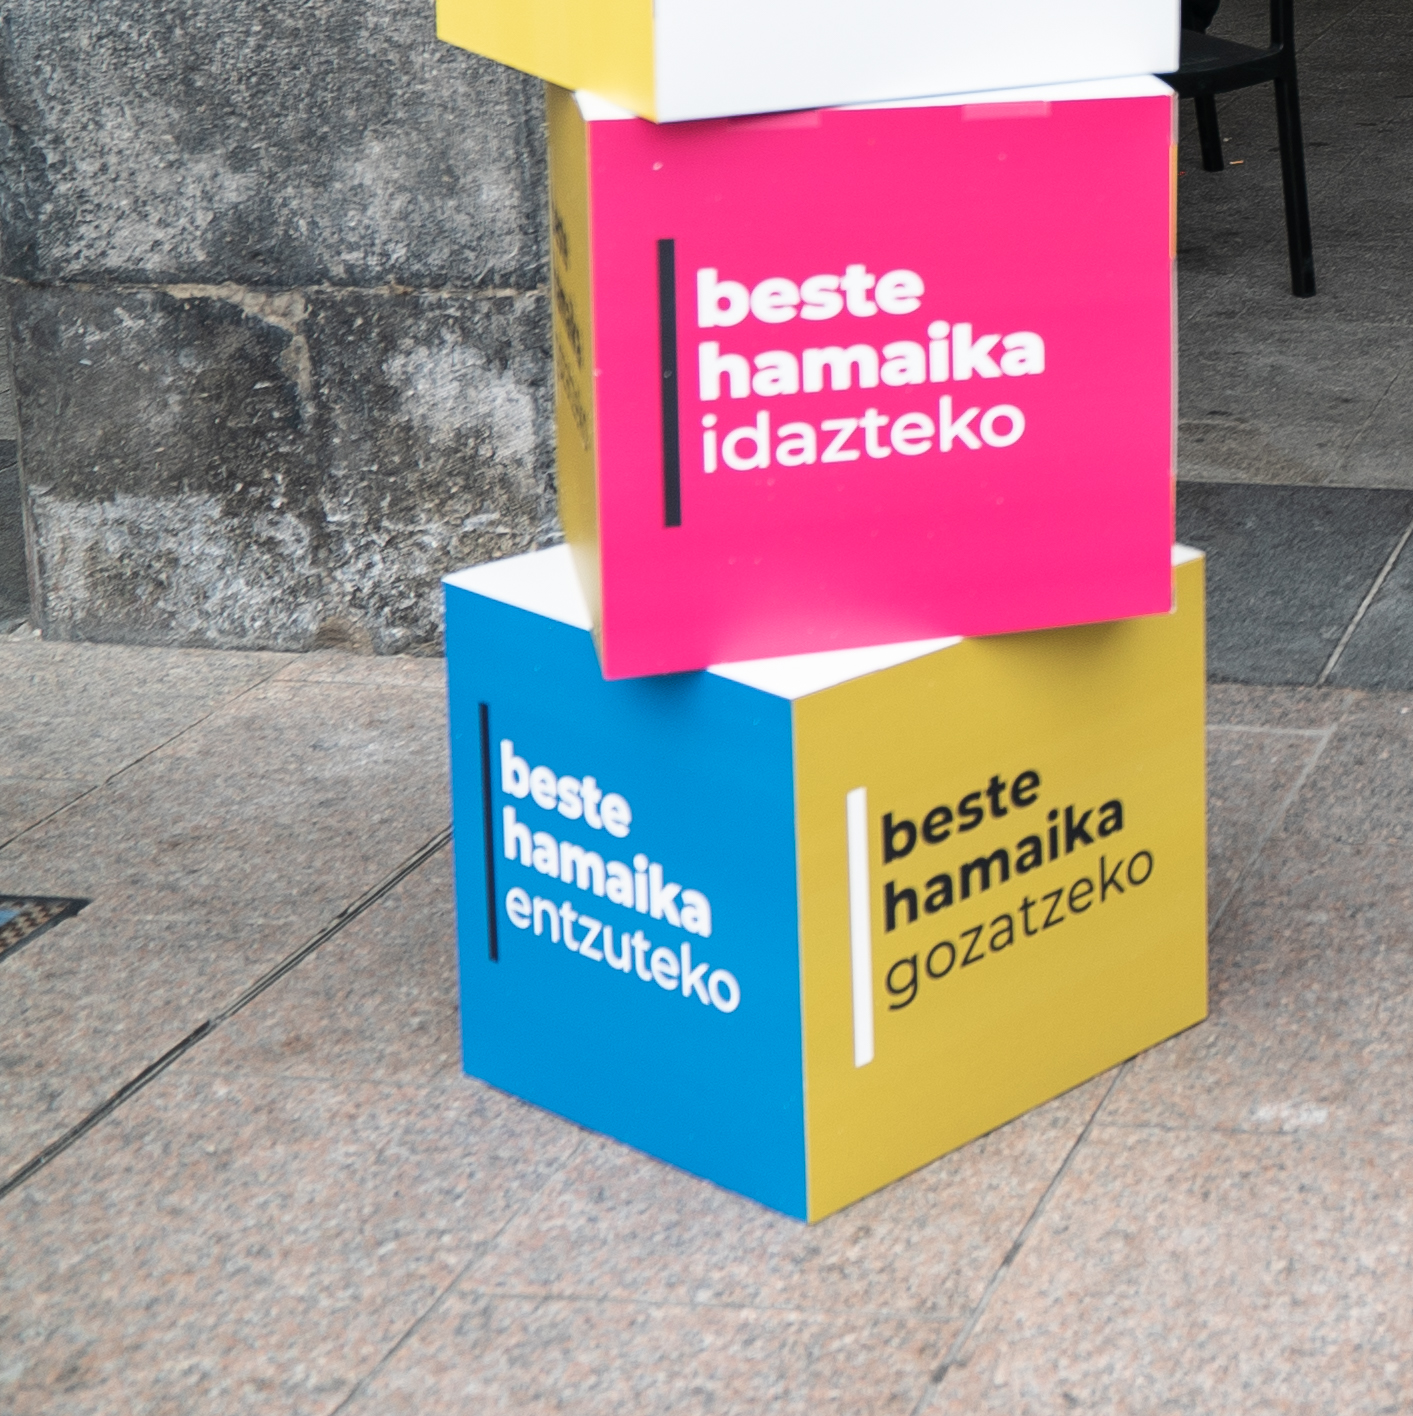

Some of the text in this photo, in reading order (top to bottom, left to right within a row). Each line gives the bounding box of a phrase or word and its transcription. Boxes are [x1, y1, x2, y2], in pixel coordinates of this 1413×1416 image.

[697, 264, 924, 328] beste
[698, 321, 1045, 401] hamaika
[702, 396, 1026, 474] idazteko
[500, 739, 632, 839] beste
[881, 767, 1042, 865] beste
[501, 807, 713, 938] hamaika
[883, 798, 1125, 933] hamaika
[506, 886, 741, 1015] entzuteko
[884, 848, 1156, 1011] gozatzeko
